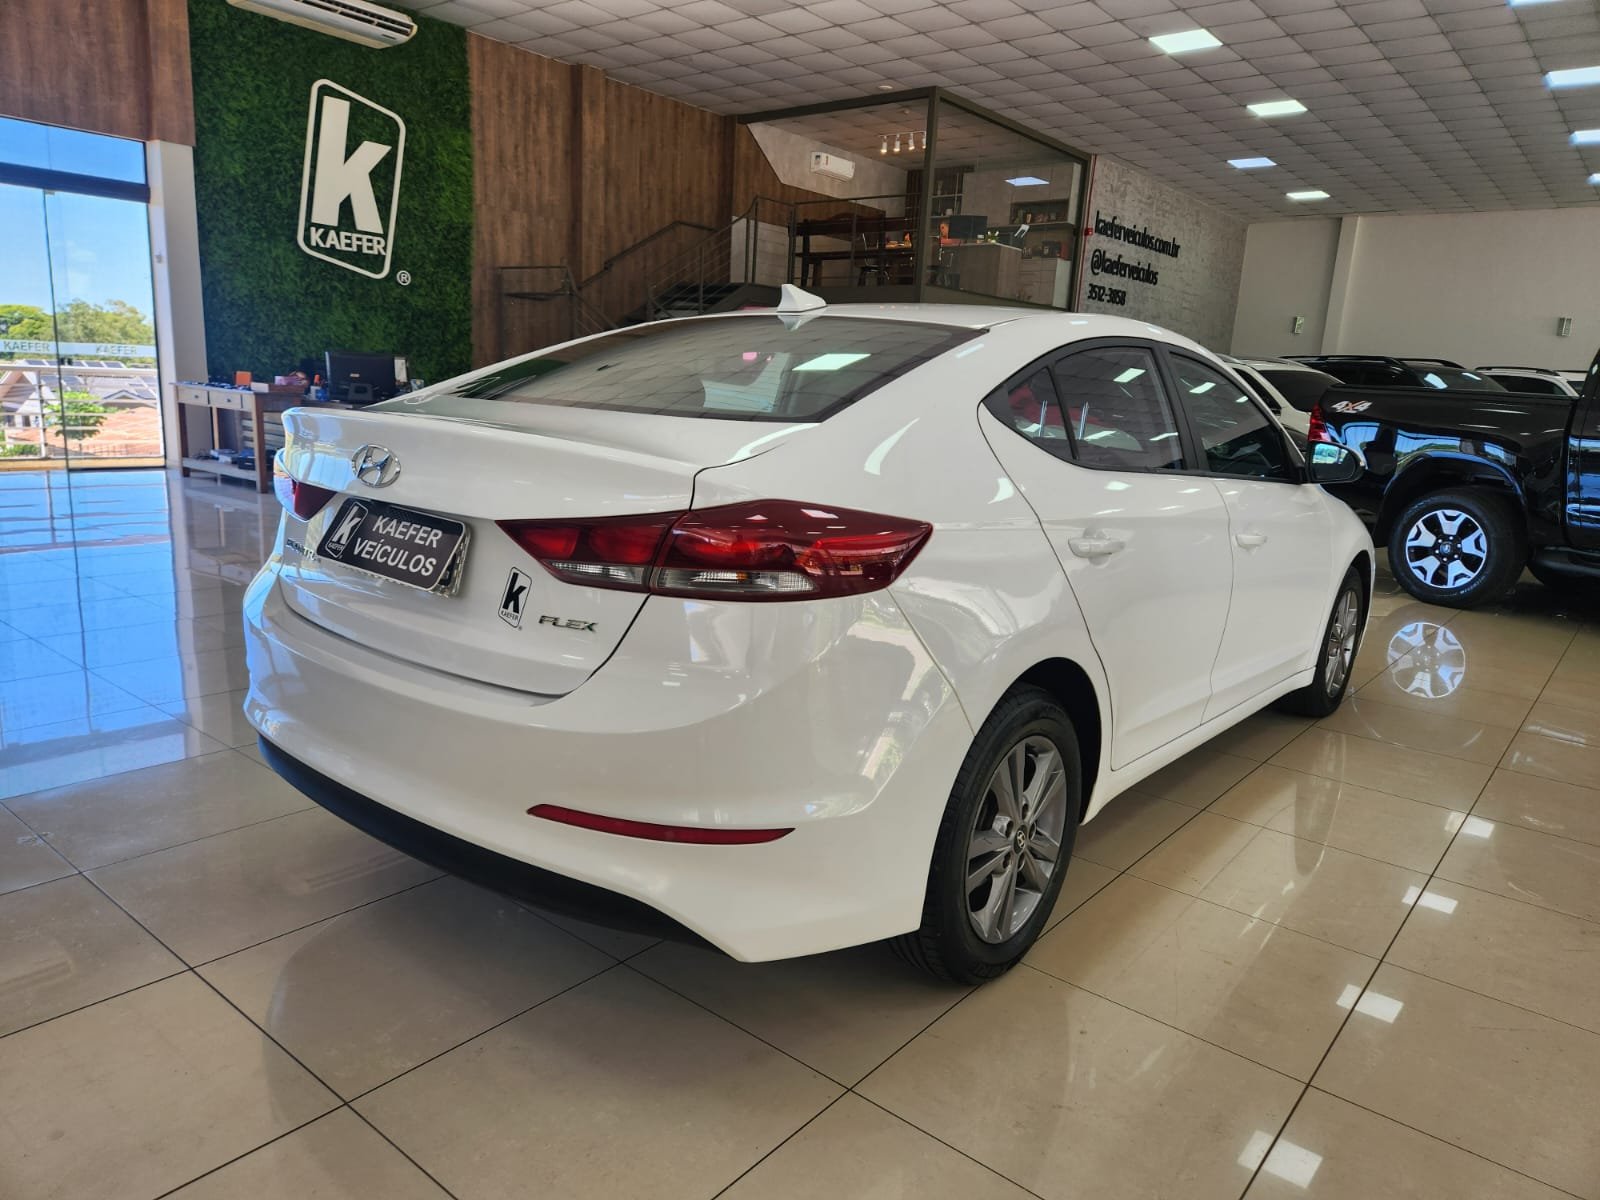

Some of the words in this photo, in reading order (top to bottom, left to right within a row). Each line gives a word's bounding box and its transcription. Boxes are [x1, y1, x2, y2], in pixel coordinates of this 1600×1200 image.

[309, 226, 386, 256] KAEFER
[1094, 209, 1181, 258] kaeferveiculos.com.br
[1090, 248, 1159, 286] @kaeferveiculos
[3, 341, 50, 352] KAEFER
[95, 344, 137, 355] KAEFER
[372, 515, 443, 548] KAEFER
[353, 537, 437, 576] VEÍCULOS
[538, 615, 599, 633] FLEX
